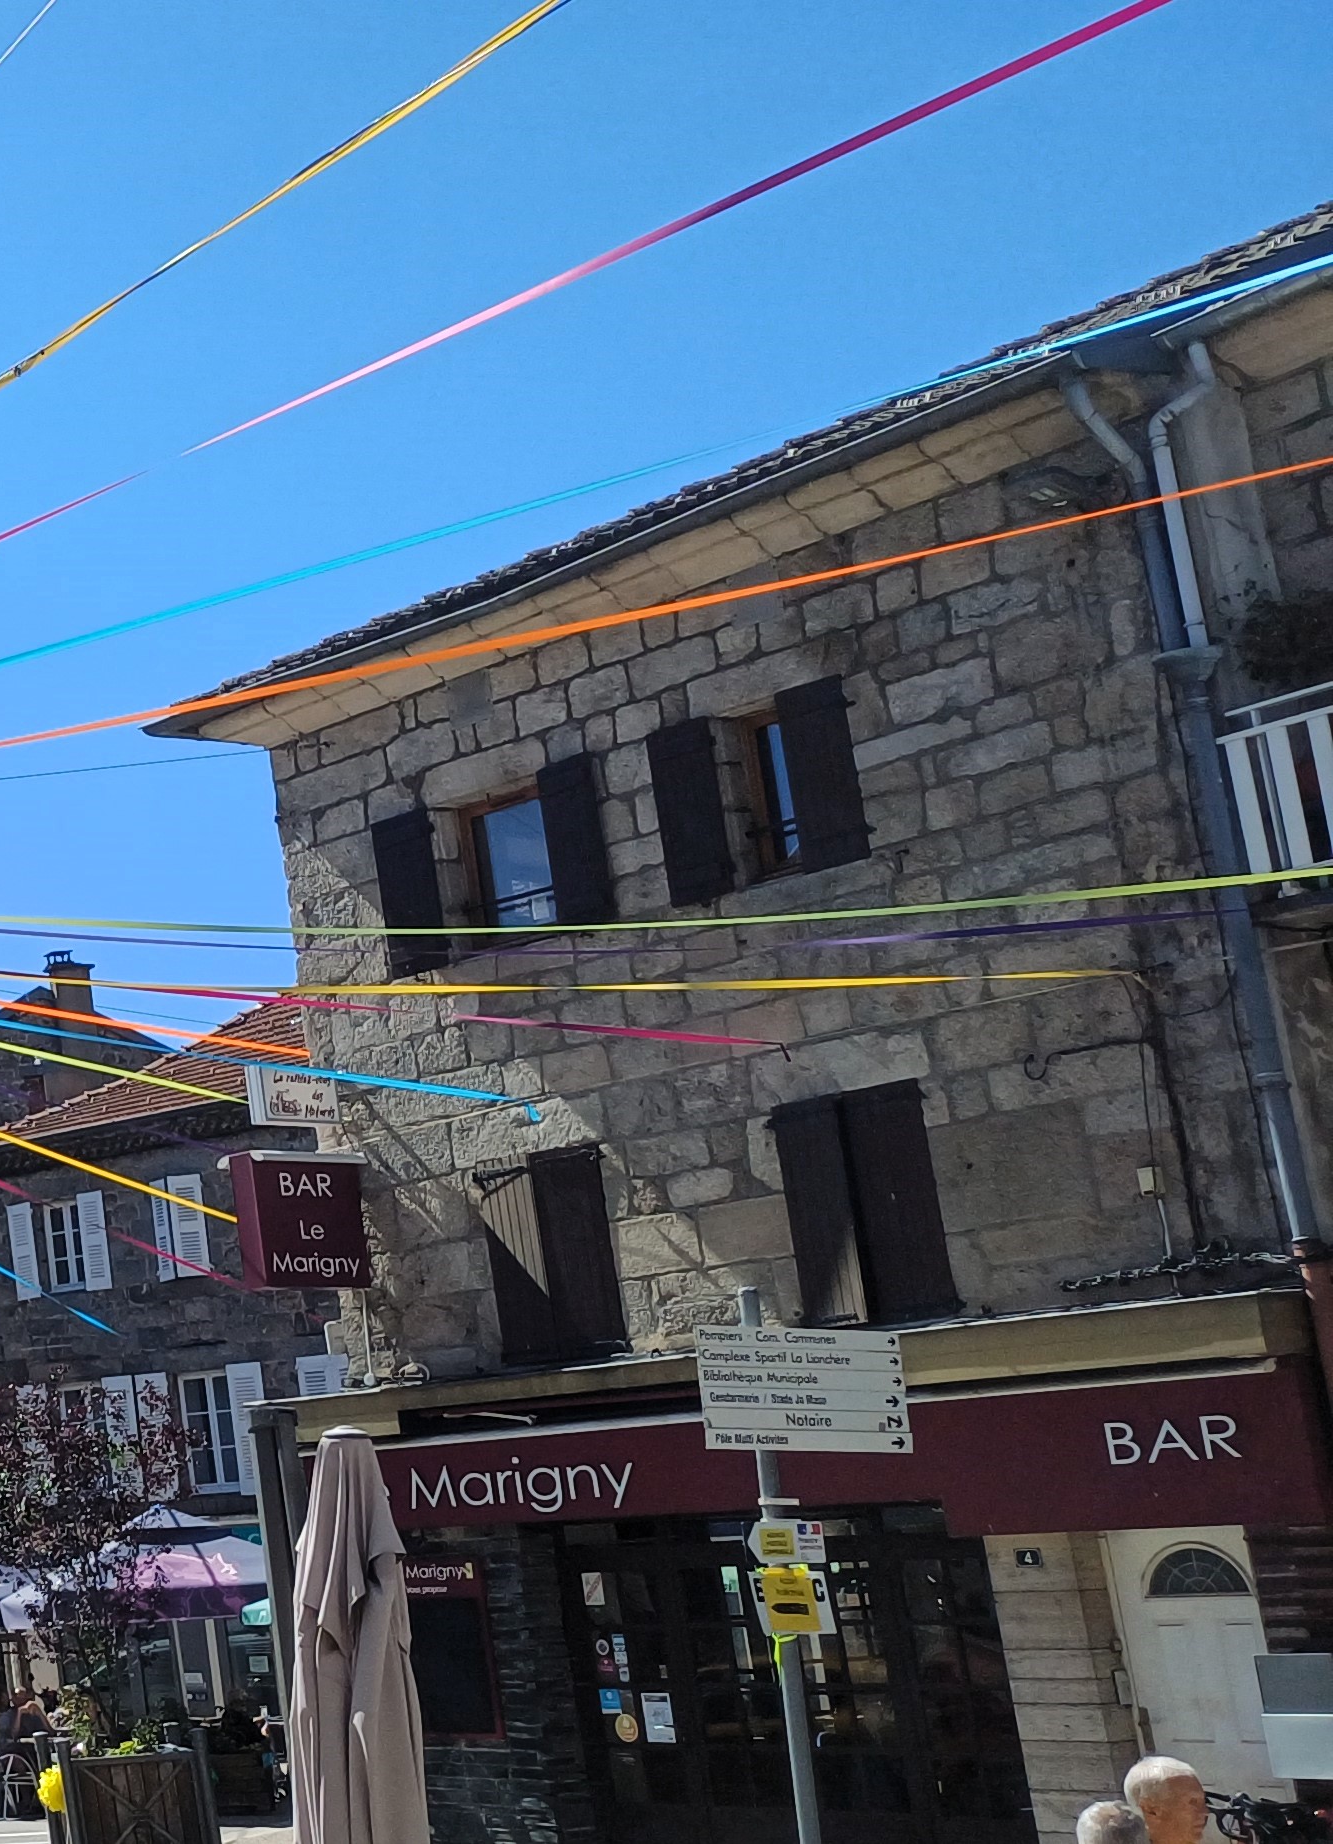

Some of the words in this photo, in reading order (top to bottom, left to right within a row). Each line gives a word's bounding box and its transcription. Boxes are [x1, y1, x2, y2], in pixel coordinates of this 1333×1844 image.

[279, 1173, 333, 1198] BAR
[300, 1220, 325, 1240] Le
[273, 1252, 360, 1278] Marigny
[702, 1349, 751, 1363] Complexe
[767, 1372, 819, 1387] Municipale
[785, 1413, 832, 1427] Notaire
[1103, 1414, 1242, 1465] BAR
[410, 1456, 633, 1513] Marigny
[1024, 1551, 1033, 1564] 4
[405, 1563, 464, 1580] Marigny
